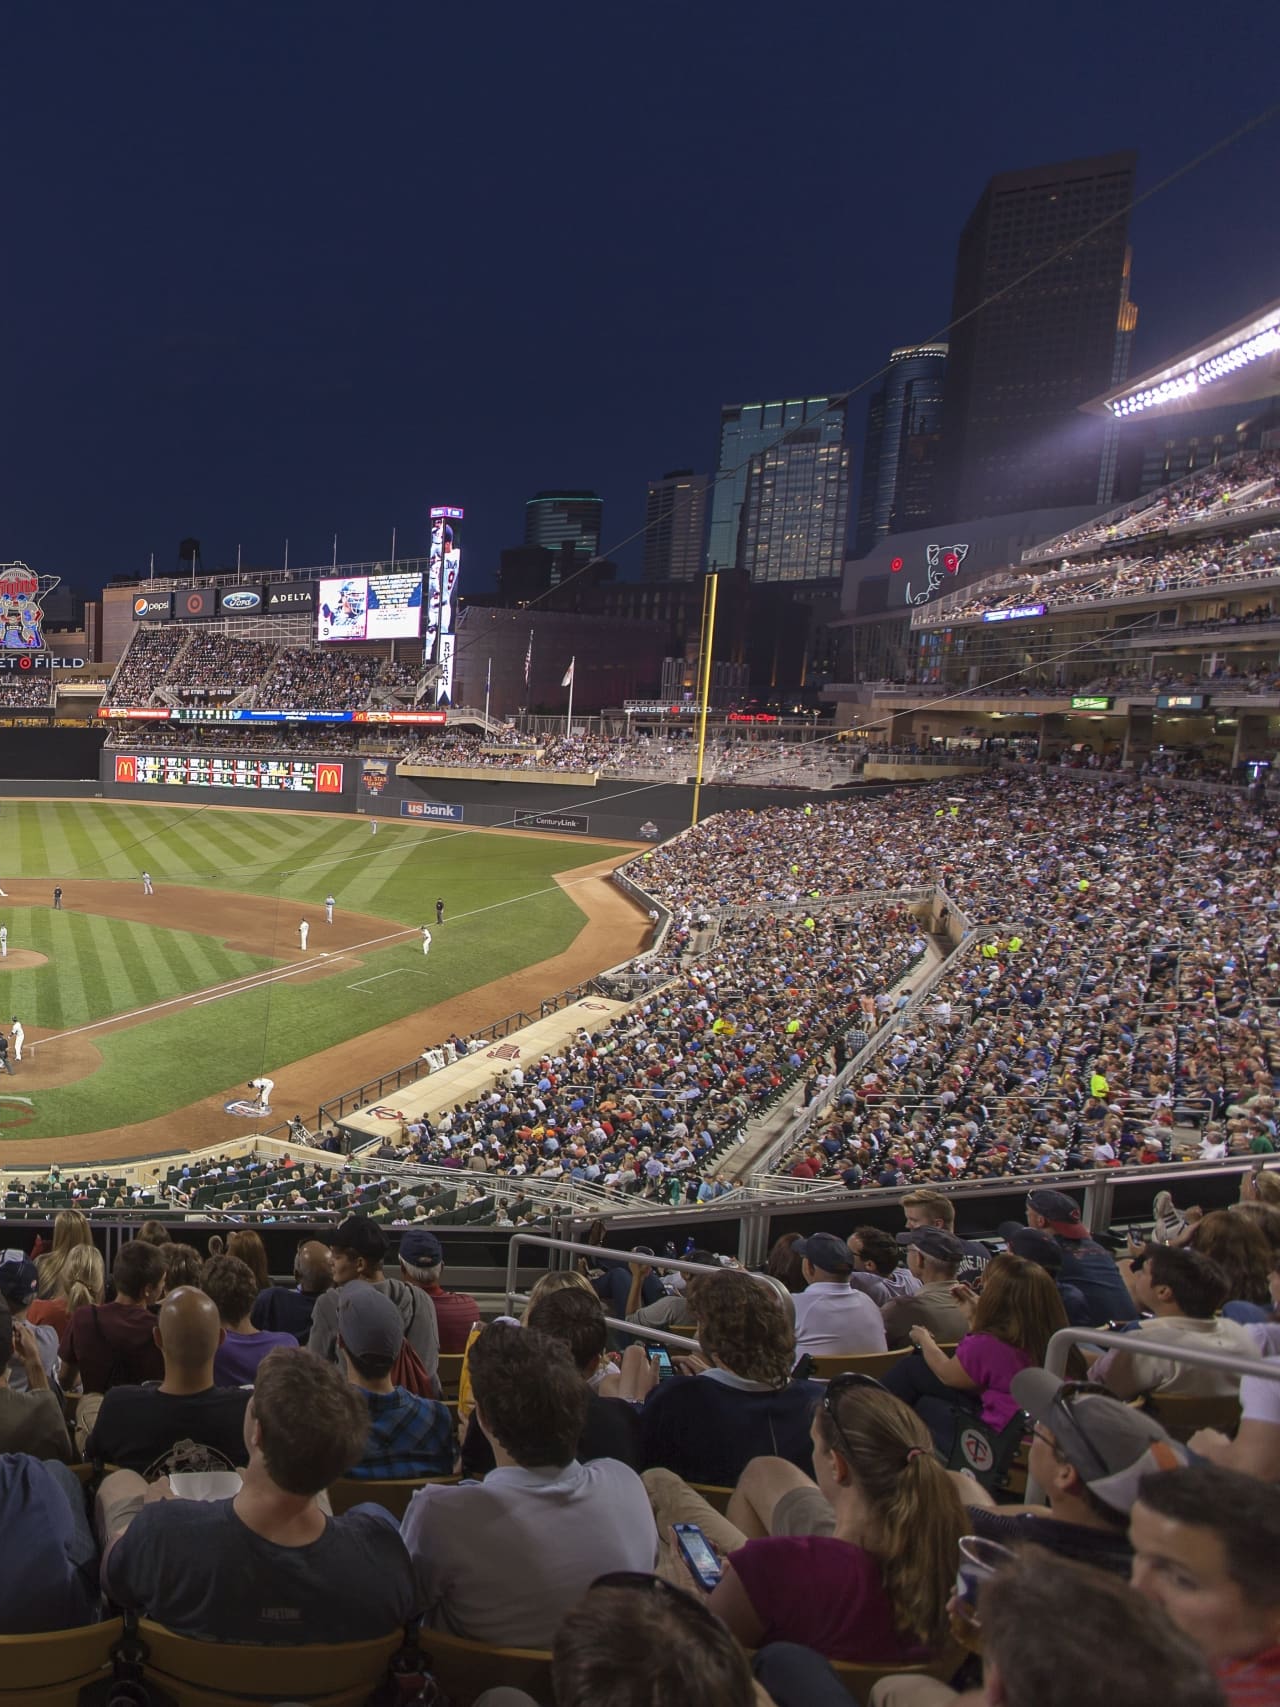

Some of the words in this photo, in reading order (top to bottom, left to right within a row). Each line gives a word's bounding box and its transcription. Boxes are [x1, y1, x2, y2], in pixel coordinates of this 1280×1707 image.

[229, 595, 252, 606] Ford
[280, 593, 312, 602] DELTA
[149, 601, 168, 611] pepsi
[323, 628, 330, 636] 9
[35, 657, 85, 668] FIELD
[441, 642, 450, 685] RYAN
[536, 817, 576, 827] CenturyLink
